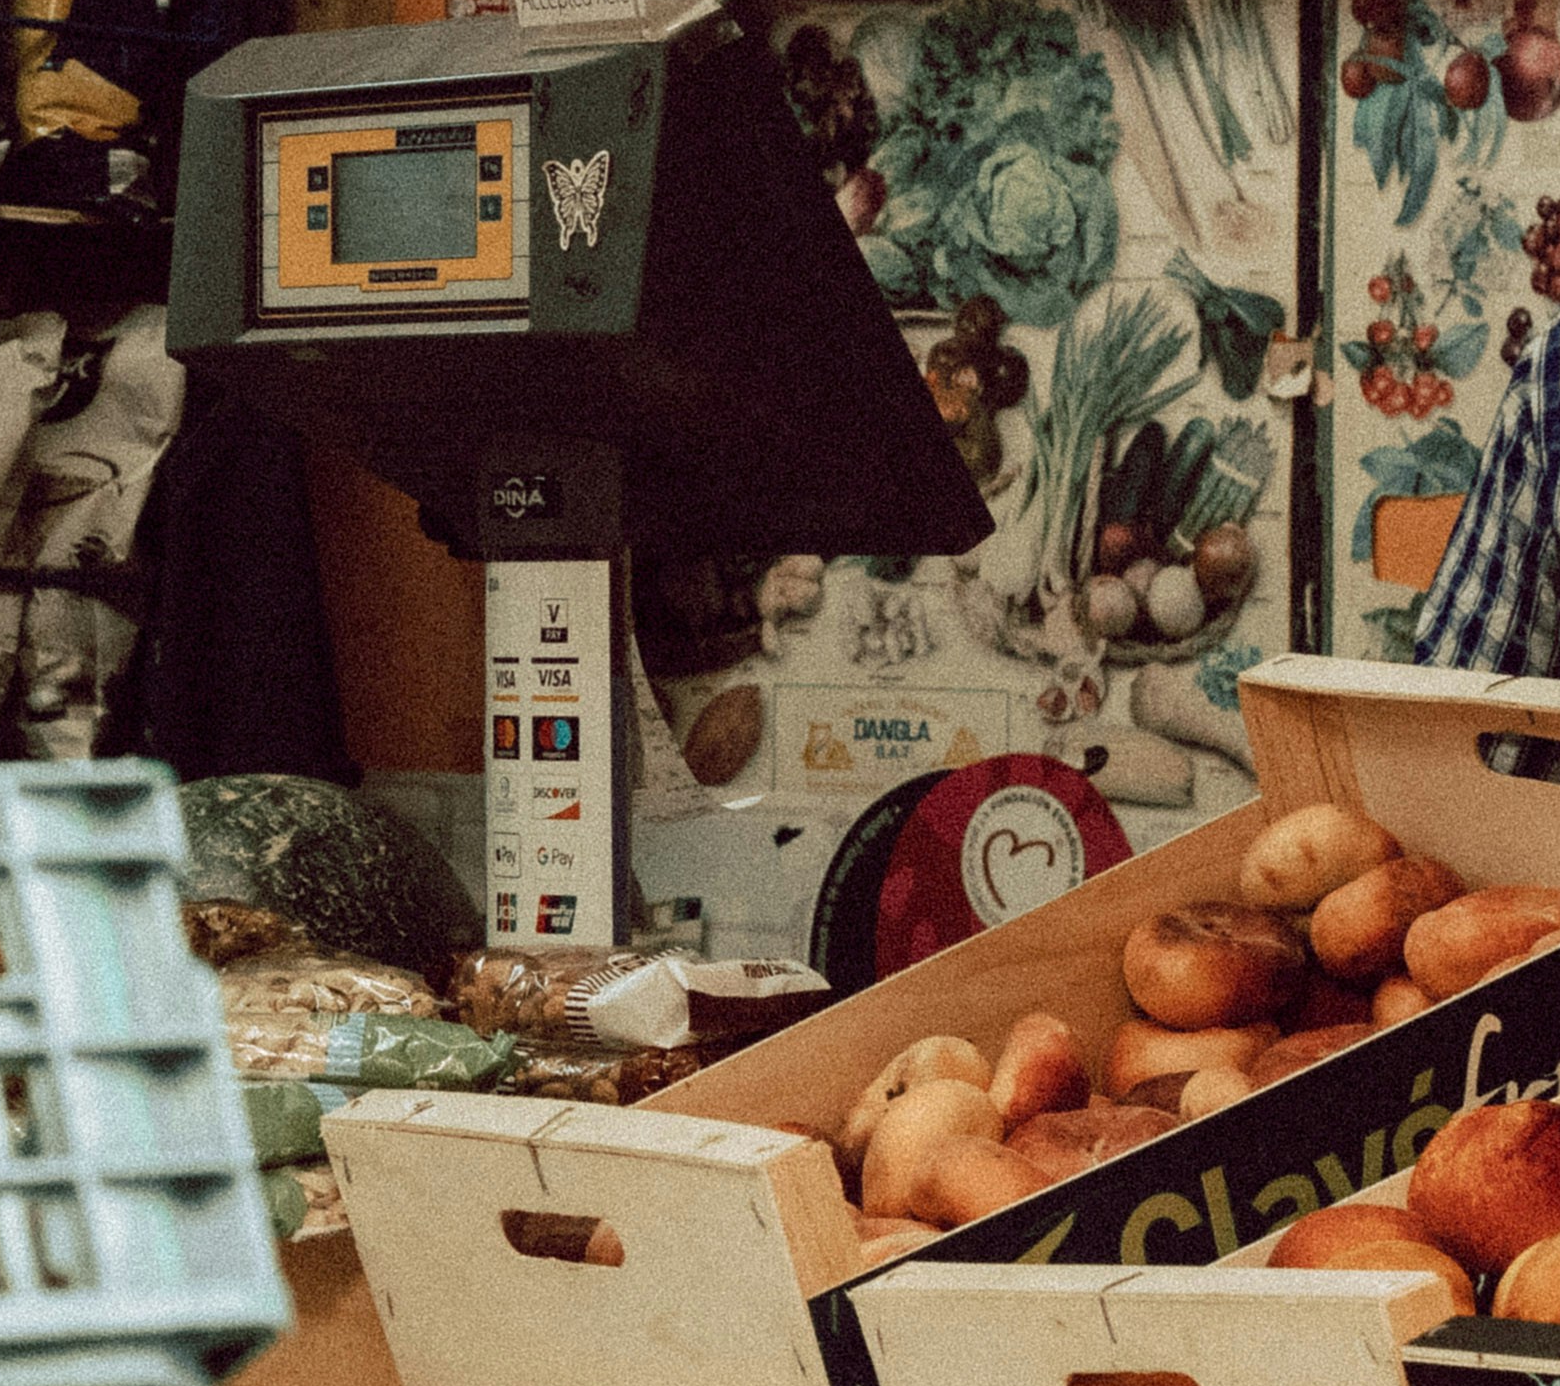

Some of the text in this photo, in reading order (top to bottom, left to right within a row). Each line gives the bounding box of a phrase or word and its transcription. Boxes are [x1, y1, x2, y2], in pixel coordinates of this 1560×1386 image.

[547, 604, 561, 624] V
[495, 669, 516, 689] VISA
[538, 669, 572, 687] VISA
[551, 848, 575, 870] Pay
